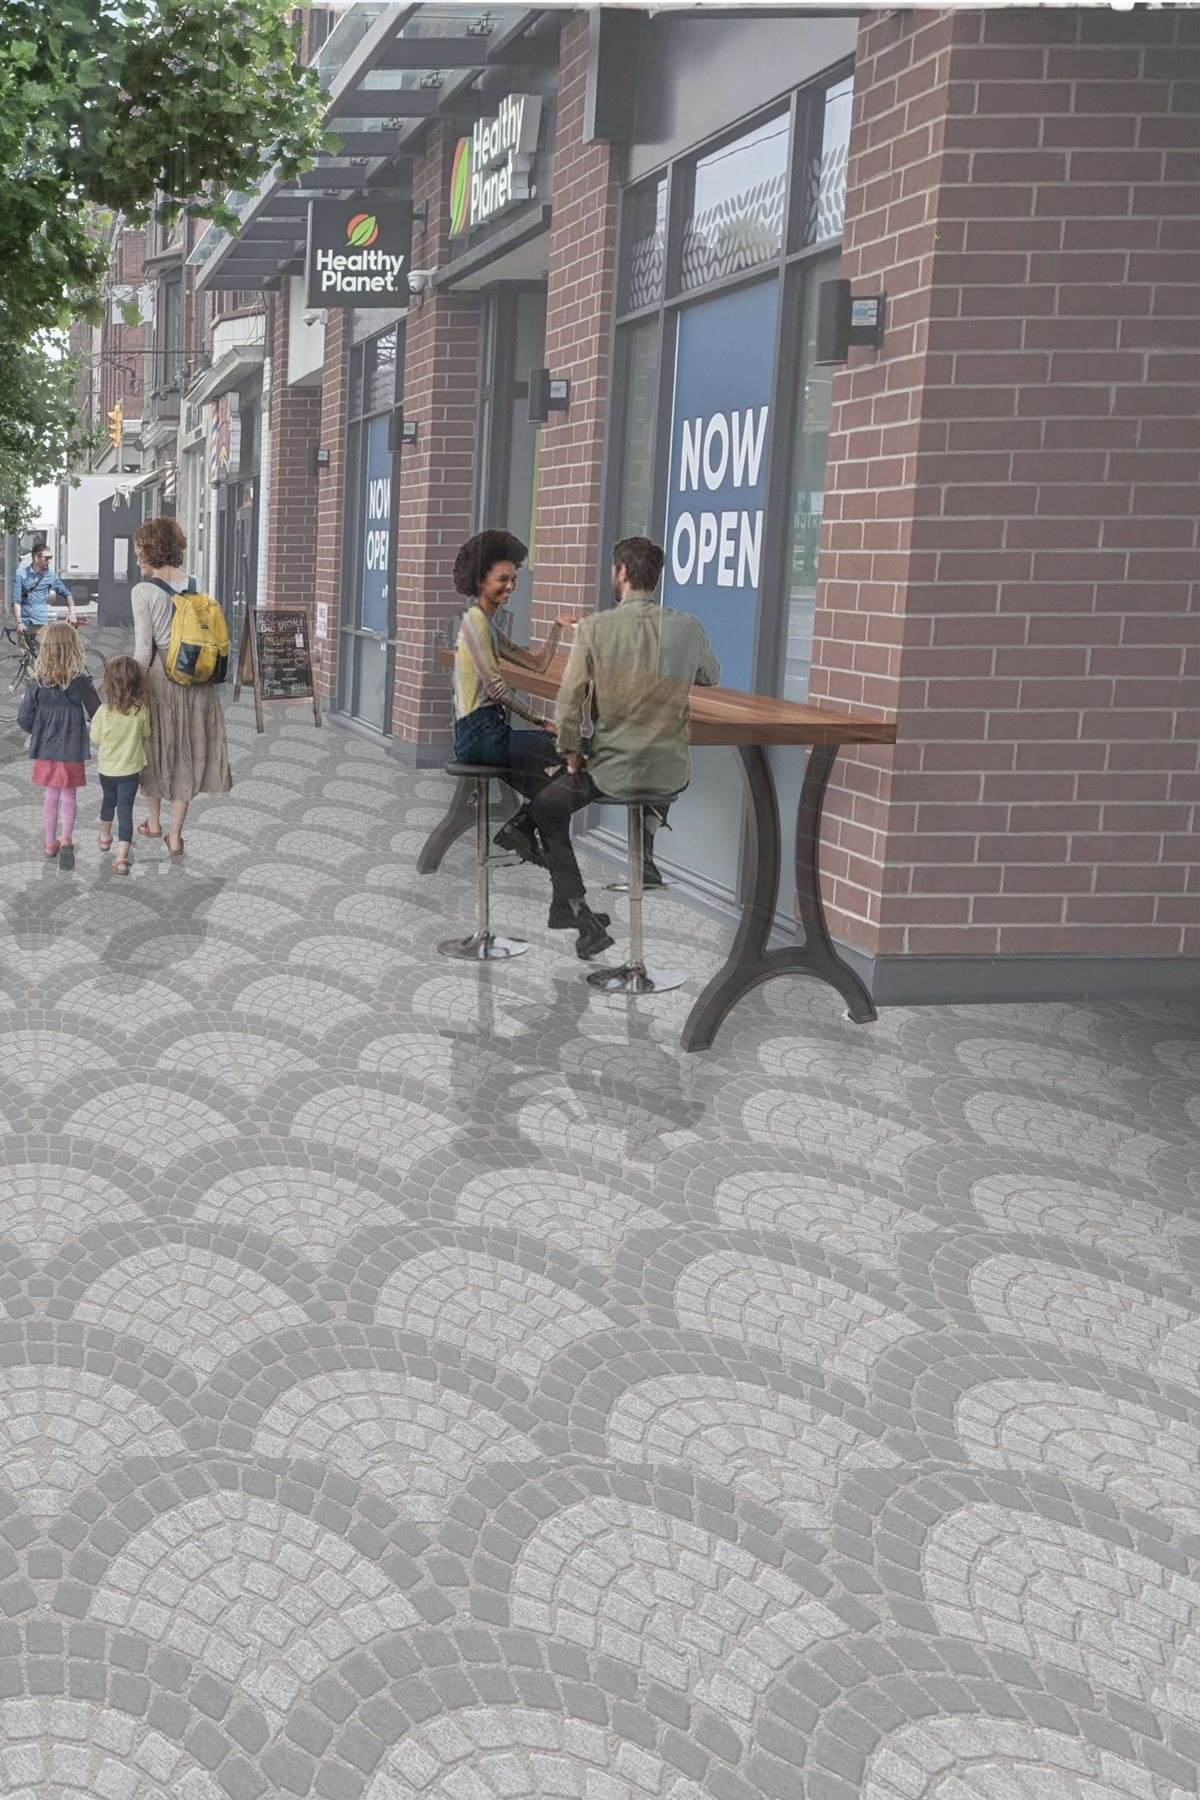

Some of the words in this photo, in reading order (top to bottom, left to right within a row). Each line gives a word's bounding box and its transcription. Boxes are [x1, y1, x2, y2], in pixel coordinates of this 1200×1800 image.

[472, 94, 525, 174] Healthy
[470, 149, 513, 226] Planet
[316, 249, 405, 276] Healthy
[321, 271, 395, 292] Planet
[679, 406, 770, 491] NOW
[671, 510, 764, 589] OPEN
[277, 619, 303, 631] SPECIALS
